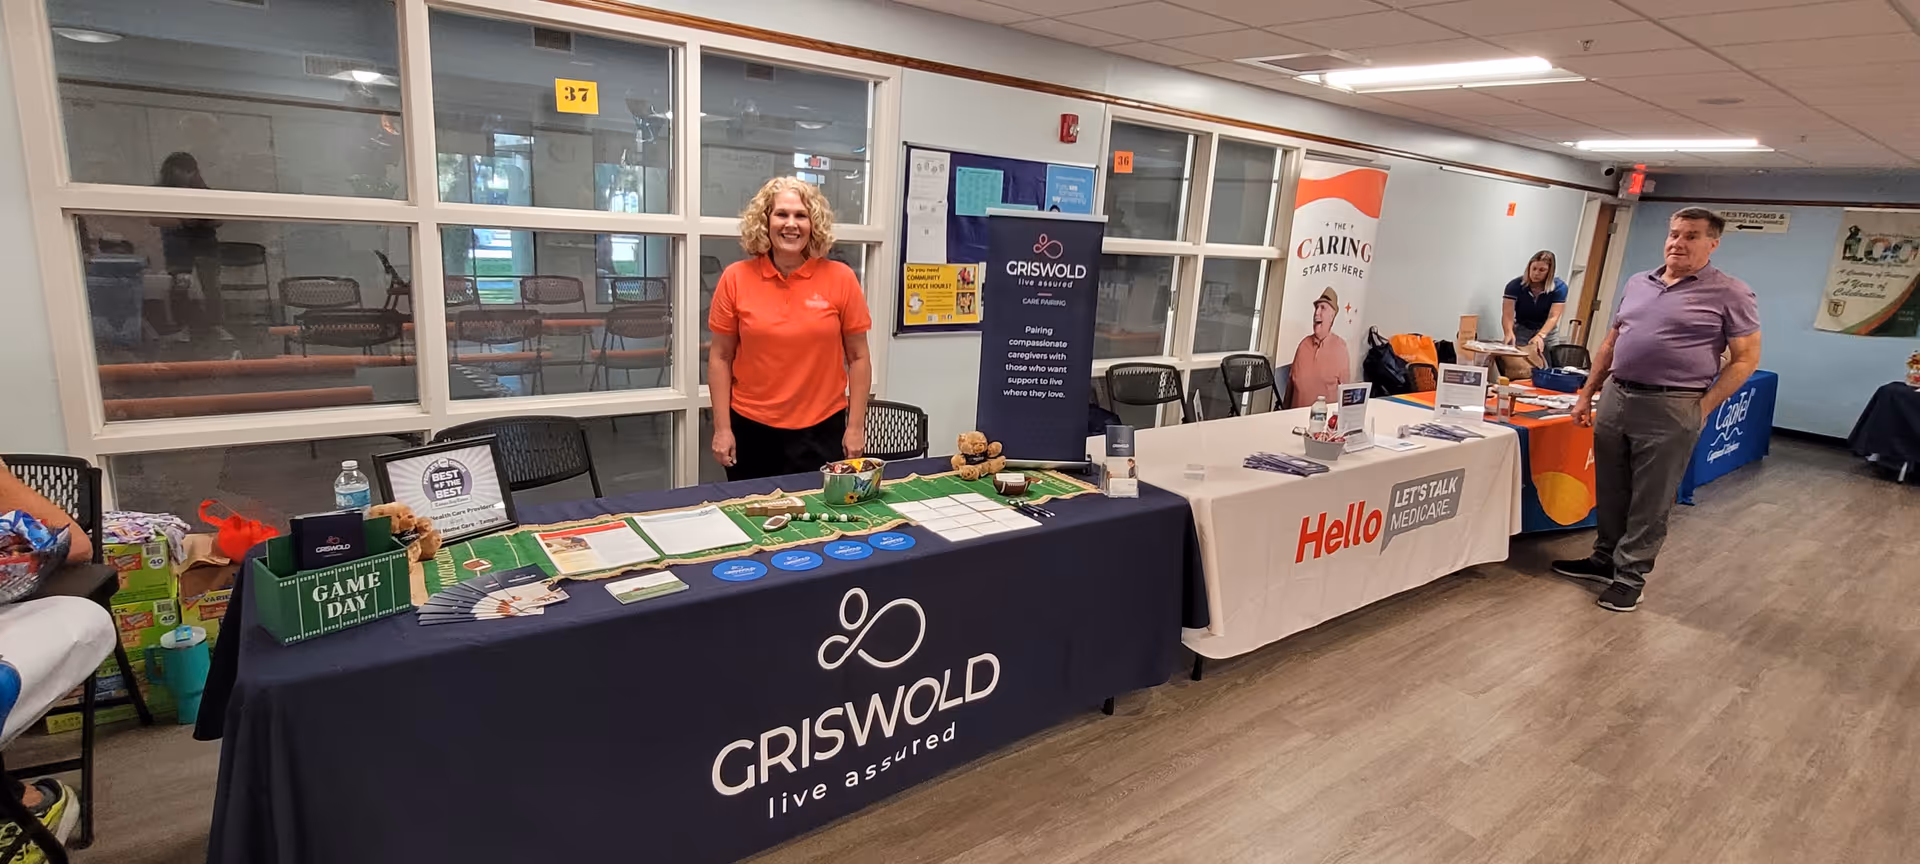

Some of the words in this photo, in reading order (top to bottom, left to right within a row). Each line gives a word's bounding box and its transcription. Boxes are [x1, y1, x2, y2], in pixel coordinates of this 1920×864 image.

[564, 86, 589, 102] 37
[1117, 155, 1130, 166] 36
[1334, 222, 1346, 230] THE
[1297, 235, 1372, 263] CARING
[1006, 261, 1087, 279] GRISWOLD
[1302, 263, 1338, 277] STARTS
[1341, 264, 1364, 279] HERE
[1018, 278, 1034, 286] live
[1040, 299, 1066, 307] PAIRING
[1025, 326, 1053, 336] Pairing
[1008, 339, 1068, 348] compassionate
[1008, 351, 1048, 360] caregivers
[1049, 352, 1067, 361] with
[1005, 363, 1027, 372] those
[1008, 377, 1038, 385] support
[1040, 377, 1048, 385] to
[1049, 378, 1063, 386] live
[1029, 390, 1047, 399] they
[1048, 390, 1066, 398] love.
[431, 470, 459, 482] BEST
[445, 478, 461, 486] THE
[435, 486, 462, 499] BEST
[1394, 483, 1428, 508] LET'S
[1428, 476, 1458, 499] TALK
[467, 504, 495, 513] Providers
[1390, 498, 1451, 531] MEDICARE.
[480, 516, 498, 525] Tampa
[1295, 500, 1382, 564] Hello
[312, 571, 381, 603] GAME
[327, 593, 369, 620] DAY
[711, 653, 1000, 796] GRISWOLD
[769, 783, 827, 819] live
[844, 722, 956, 787] assured
